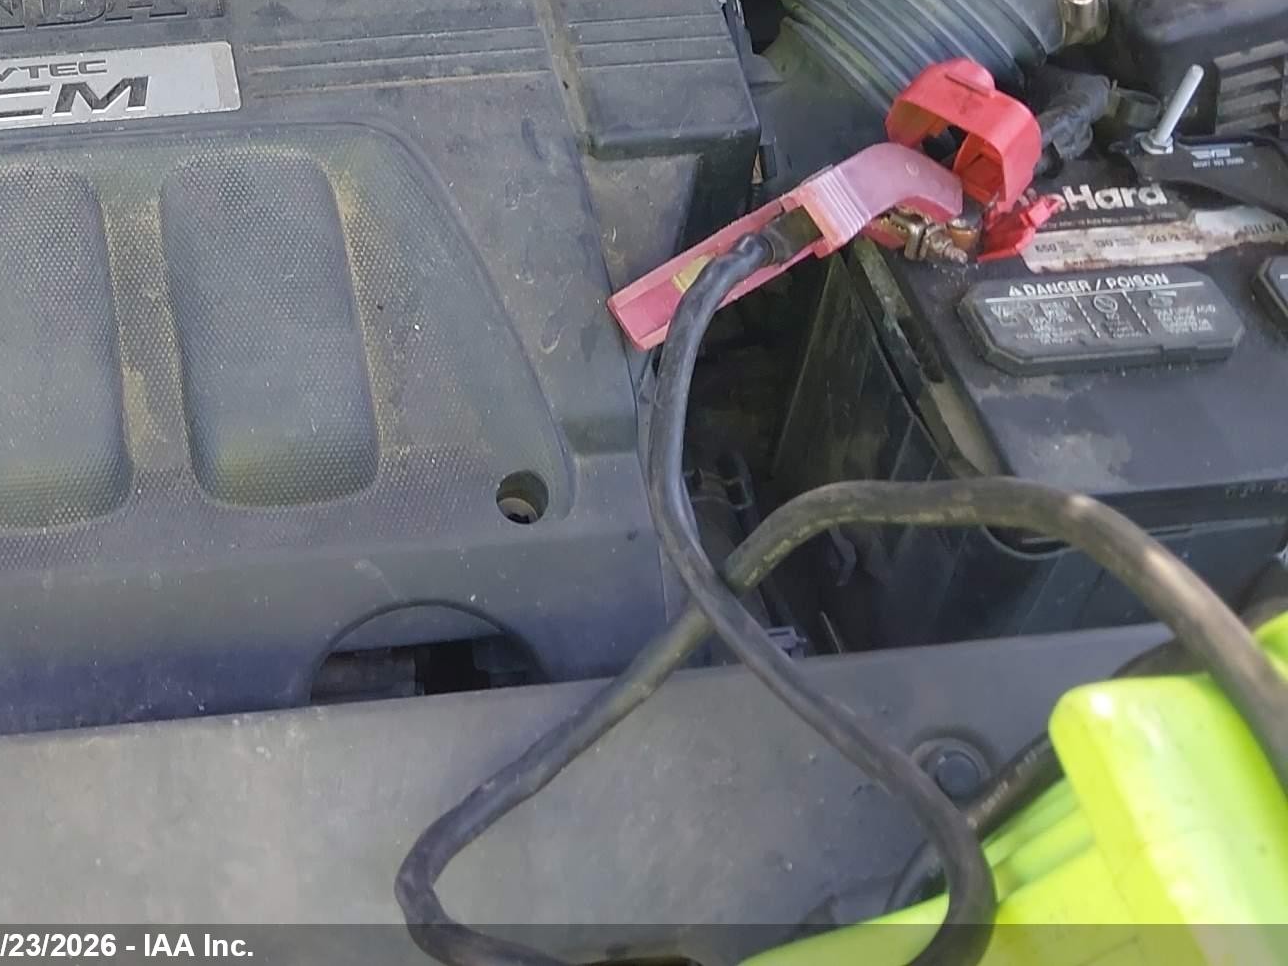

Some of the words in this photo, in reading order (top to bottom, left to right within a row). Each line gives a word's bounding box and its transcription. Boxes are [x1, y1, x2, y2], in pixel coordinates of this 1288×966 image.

[1018, 183, 1168, 211] Hard
[1022, 279, 1092, 296] DANGER
[1105, 272, 1170, 290] POISON
